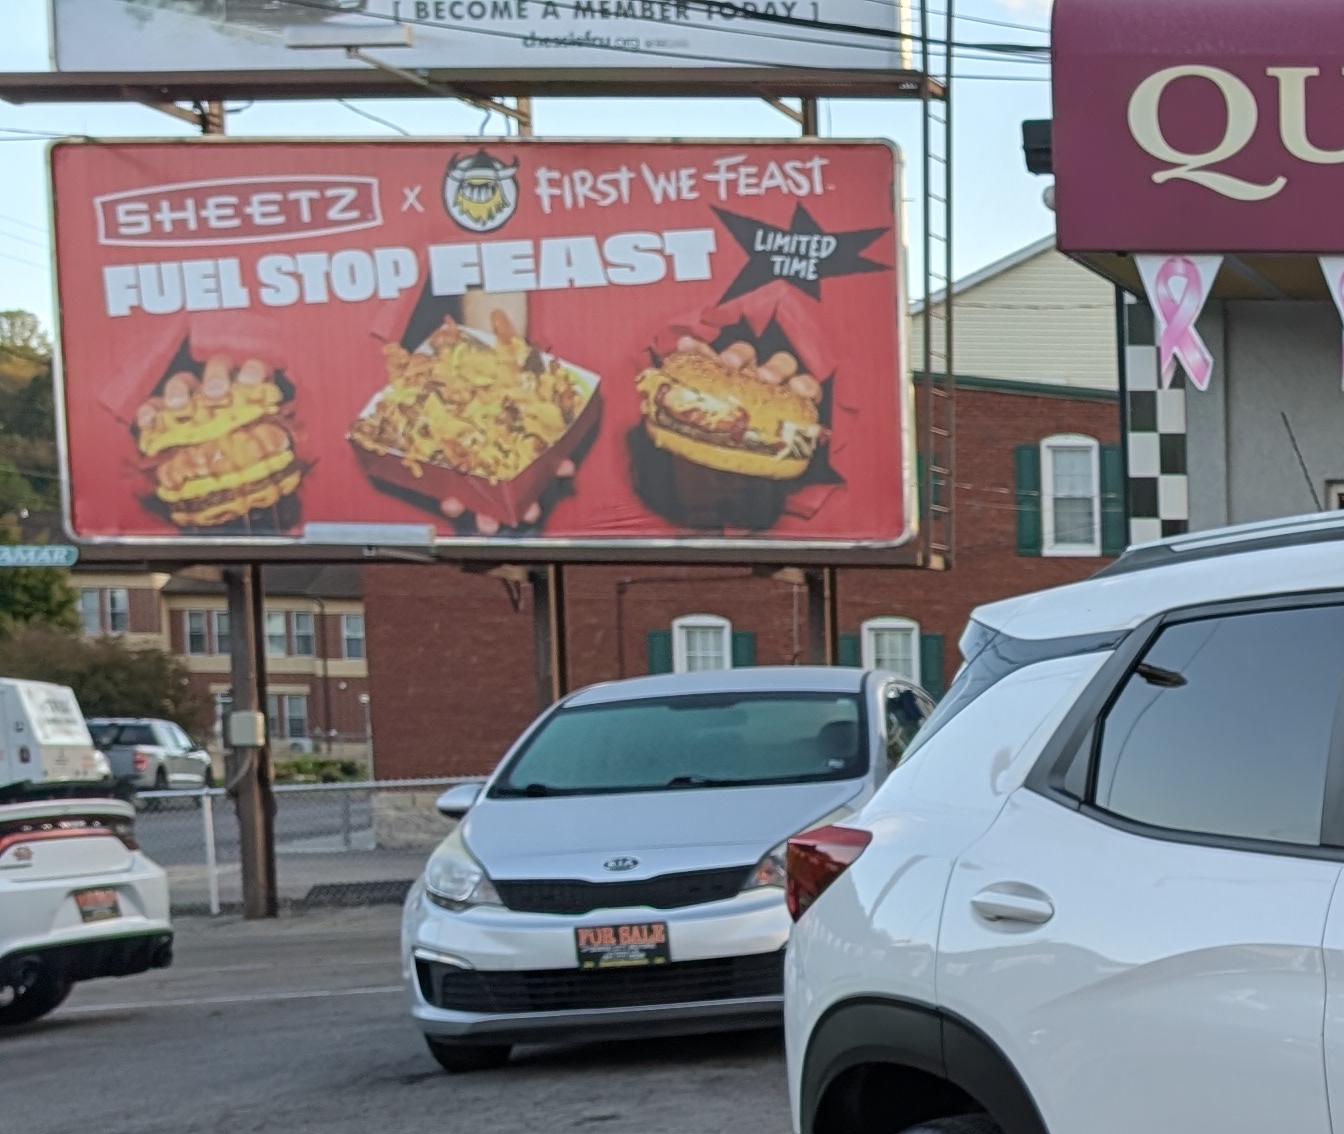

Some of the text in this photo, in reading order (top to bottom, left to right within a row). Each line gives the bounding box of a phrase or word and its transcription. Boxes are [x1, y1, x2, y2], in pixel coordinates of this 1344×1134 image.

[414, 0, 529, 20] BECOME
[541, 0, 561, 20] A
[574, 0, 690, 21] MEMBER
[702, 0, 797, 20] TODAY
[115, 187, 361, 235] SHEETZ
[534, 163, 636, 214] FIRST
[639, 161, 700, 205] WE
[703, 154, 830, 201] FEAST
[753, 227, 838, 260] LIMITED
[103, 229, 717, 317] FUEL STOP FEAST
[770, 256, 820, 281] TIME
[577, 923, 665, 948] FOR SALE
